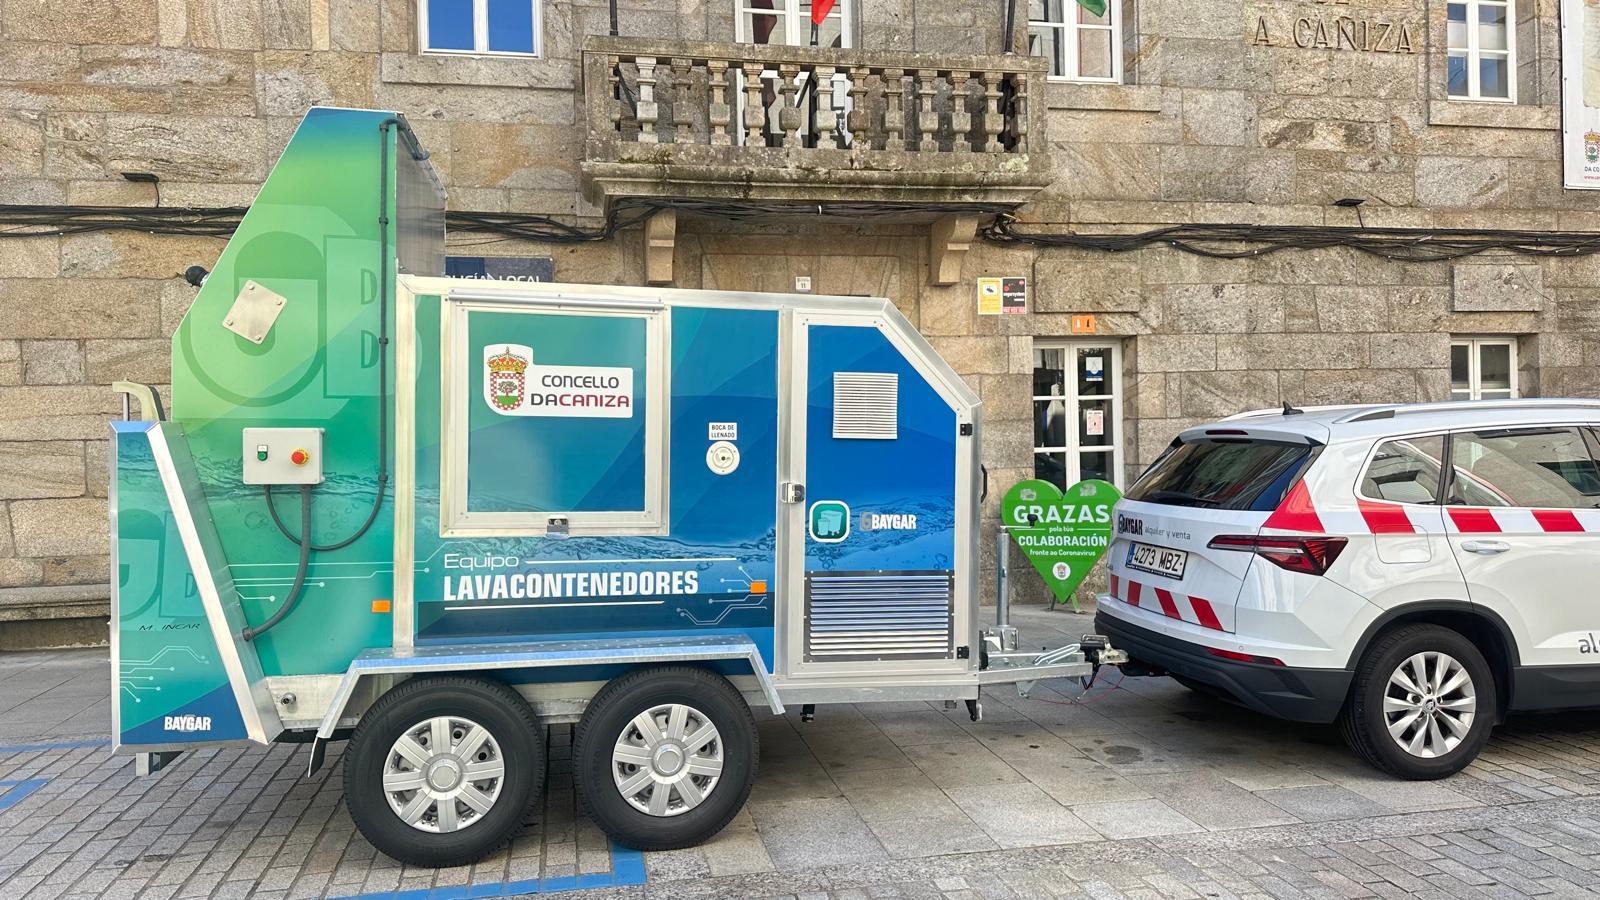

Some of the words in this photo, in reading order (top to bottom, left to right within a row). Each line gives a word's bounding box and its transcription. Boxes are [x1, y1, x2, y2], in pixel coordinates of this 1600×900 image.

[1252, 15, 1276, 47] A
[1293, 16, 1416, 54] CAÑIZA
[541, 375, 620, 389] CONCELLO
[530, 393, 630, 407] DACANIZA
[1013, 504, 1110, 523] GRAZAS
[1018, 533, 1107, 546] COLABORACIÓN
[1172, 531, 1191, 540] venta
[444, 552, 519, 571] Equipo
[1134, 545, 1156, 566] 4273
[1158, 551, 1182, 572] MBZ
[443, 570, 699, 600] LAVACONTENEDORES
[1578, 632, 1600, 653] al
[164, 716, 211, 731] BAYGAR
